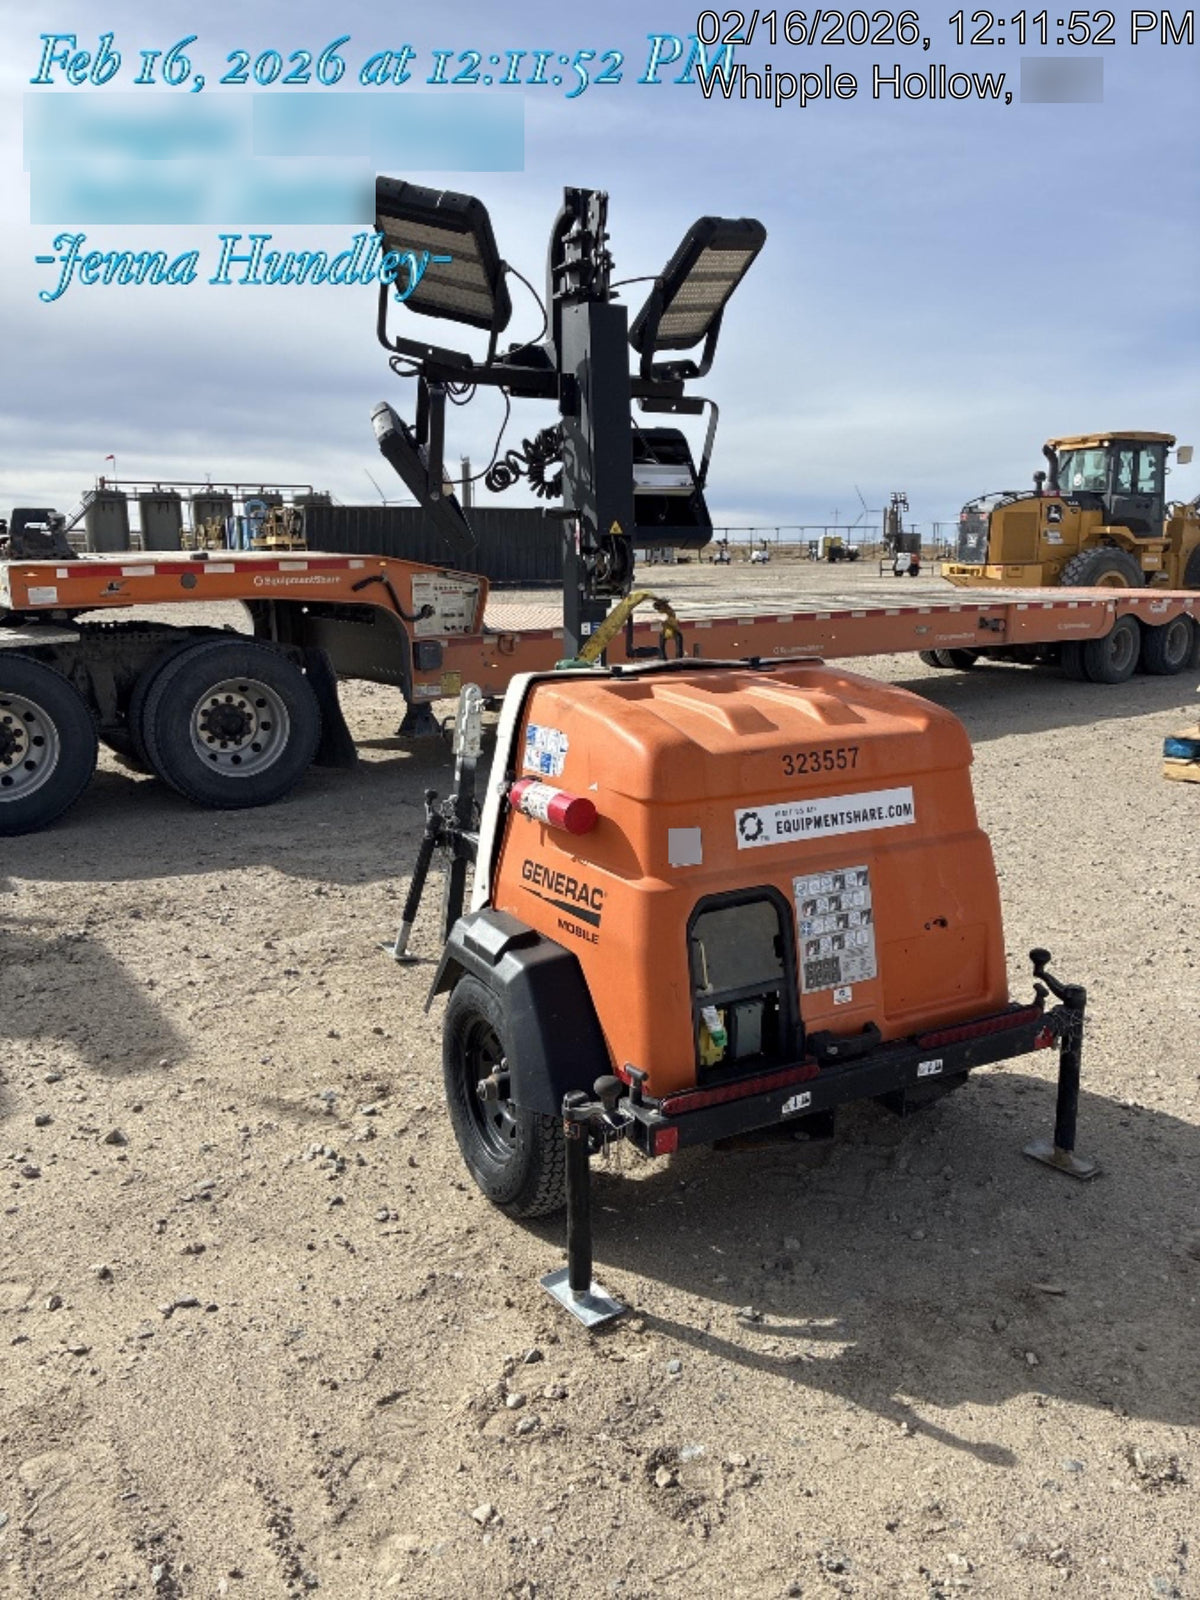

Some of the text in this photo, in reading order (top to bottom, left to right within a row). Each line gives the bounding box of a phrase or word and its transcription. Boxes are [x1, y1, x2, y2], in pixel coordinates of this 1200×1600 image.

[782, 747, 859, 774] 323557
[776, 803, 912, 834] EQUIPMENTSHARE.COM
[522, 859, 603, 910] GENERAC
[558, 918, 599, 944] MOBILE
